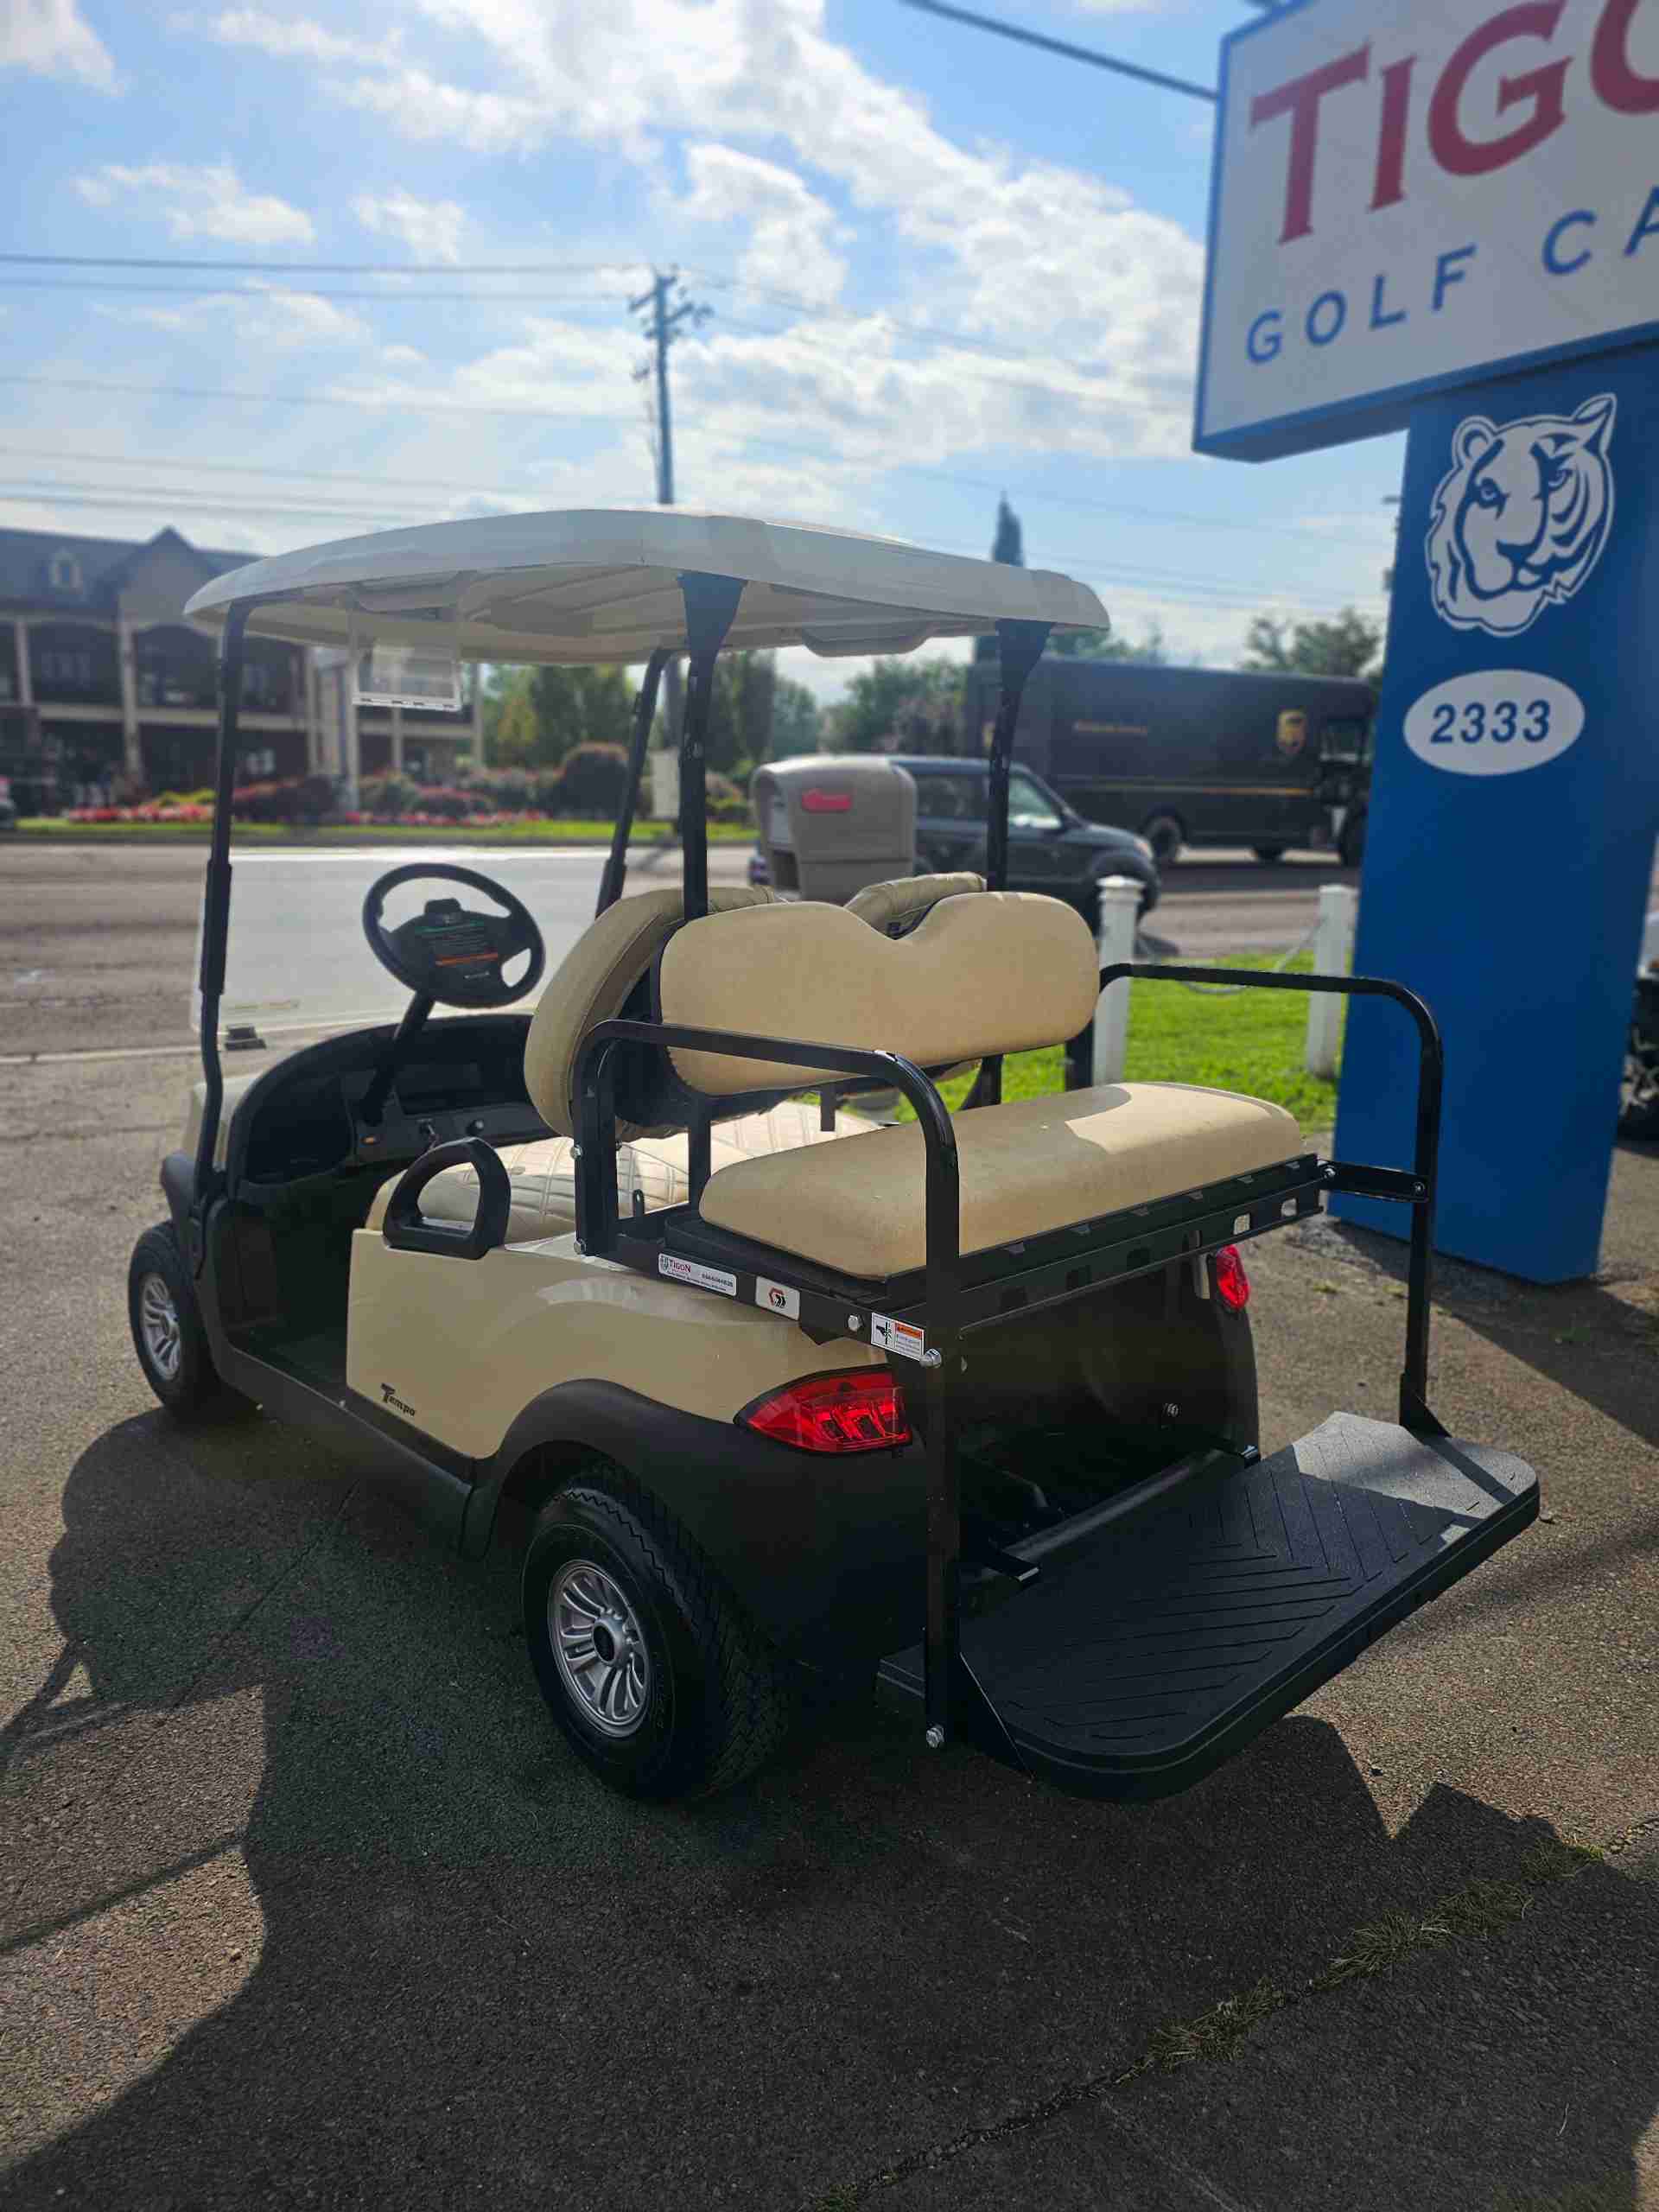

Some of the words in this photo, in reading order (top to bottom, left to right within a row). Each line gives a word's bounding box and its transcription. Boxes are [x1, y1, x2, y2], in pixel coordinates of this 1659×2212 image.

[1246, 244, 1478, 365] GOLF
[1429, 698, 1551, 744] 2333
[380, 1382, 416, 1417] Tempo
